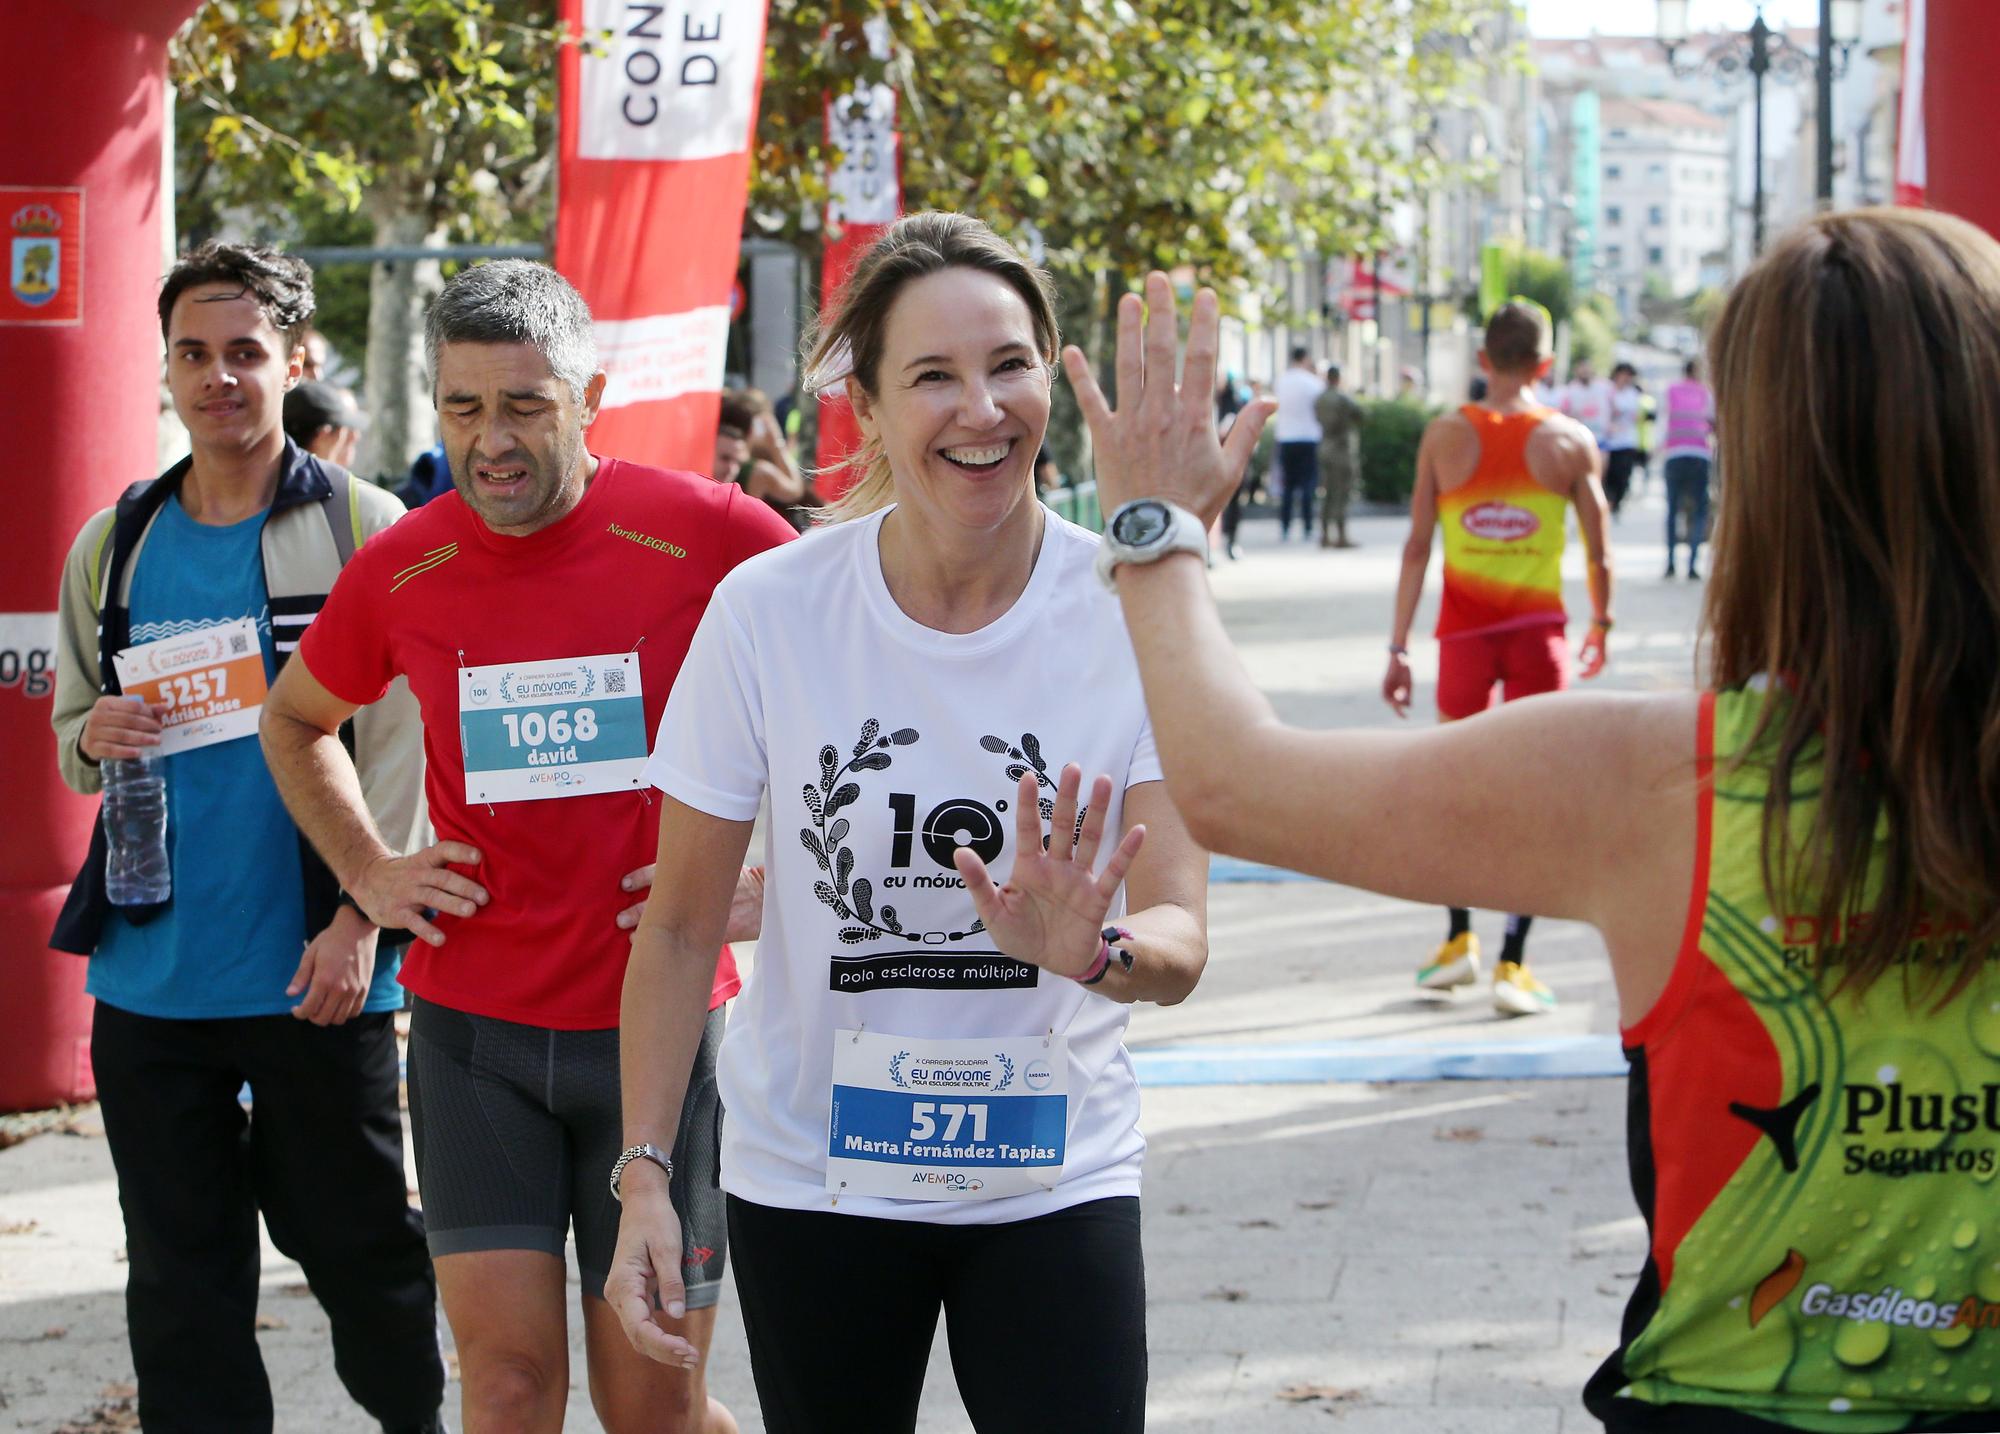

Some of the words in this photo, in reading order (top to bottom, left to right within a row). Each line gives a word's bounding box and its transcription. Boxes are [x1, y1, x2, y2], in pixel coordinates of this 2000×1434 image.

[680, 13, 722, 86] DE
[622, 5, 663, 127] CON
[606, 522, 688, 559] NorthLEGEND
[158, 667, 228, 710] 5257
[473, 688, 488, 697] 10K
[517, 684, 530, 694] EU
[533, 680, 577, 692] MÓVOME
[161, 704, 206, 727] Adrián
[207, 698, 242, 716] Jose
[502, 707, 599, 747] 1068
[527, 745, 578, 765] david
[529, 771, 570, 783] AVEMPO
[883, 876, 906, 888] eu
[840, 969, 874, 985] pola
[881, 964, 956, 979] esclerose
[963, 964, 1029, 982] múltiple
[911, 1068, 928, 1080] EU
[933, 1067, 991, 1081] MÓVOME
[921, 1058, 954, 1066] CARREIRA
[910, 1101, 988, 1142] 571
[844, 1135, 899, 1155] Marta
[903, 1141, 995, 1159] Fernández
[999, 1144, 1056, 1162] Tapias
[1844, 1144, 1995, 1178] Seguros
[912, 1172, 966, 1184] AVEMPO
